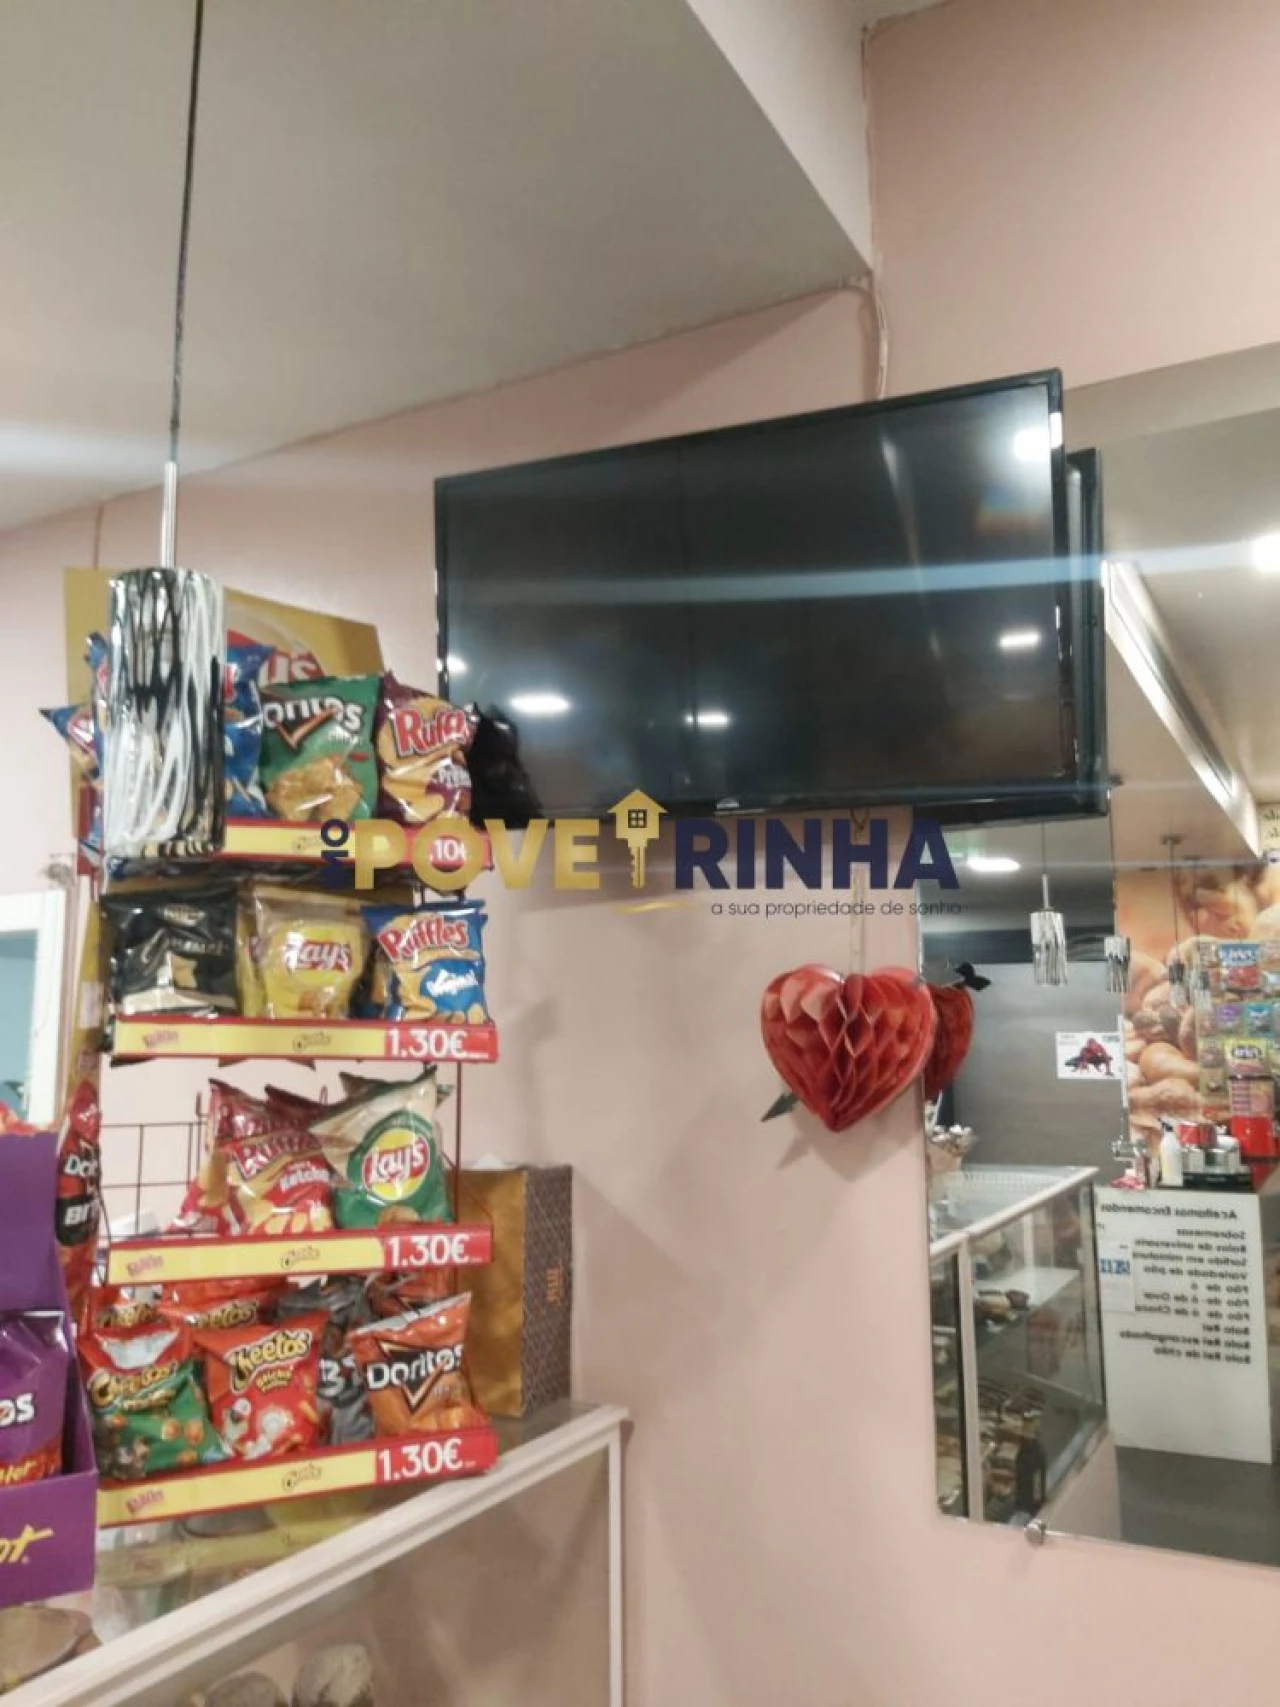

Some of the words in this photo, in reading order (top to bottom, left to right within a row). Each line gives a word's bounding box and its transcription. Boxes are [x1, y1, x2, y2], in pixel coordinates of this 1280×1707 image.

[389, 1028, 468, 1059] 1.30€
[388, 1233, 470, 1267] 1.30€
[379, 1438, 463, 1481] 1.30€
